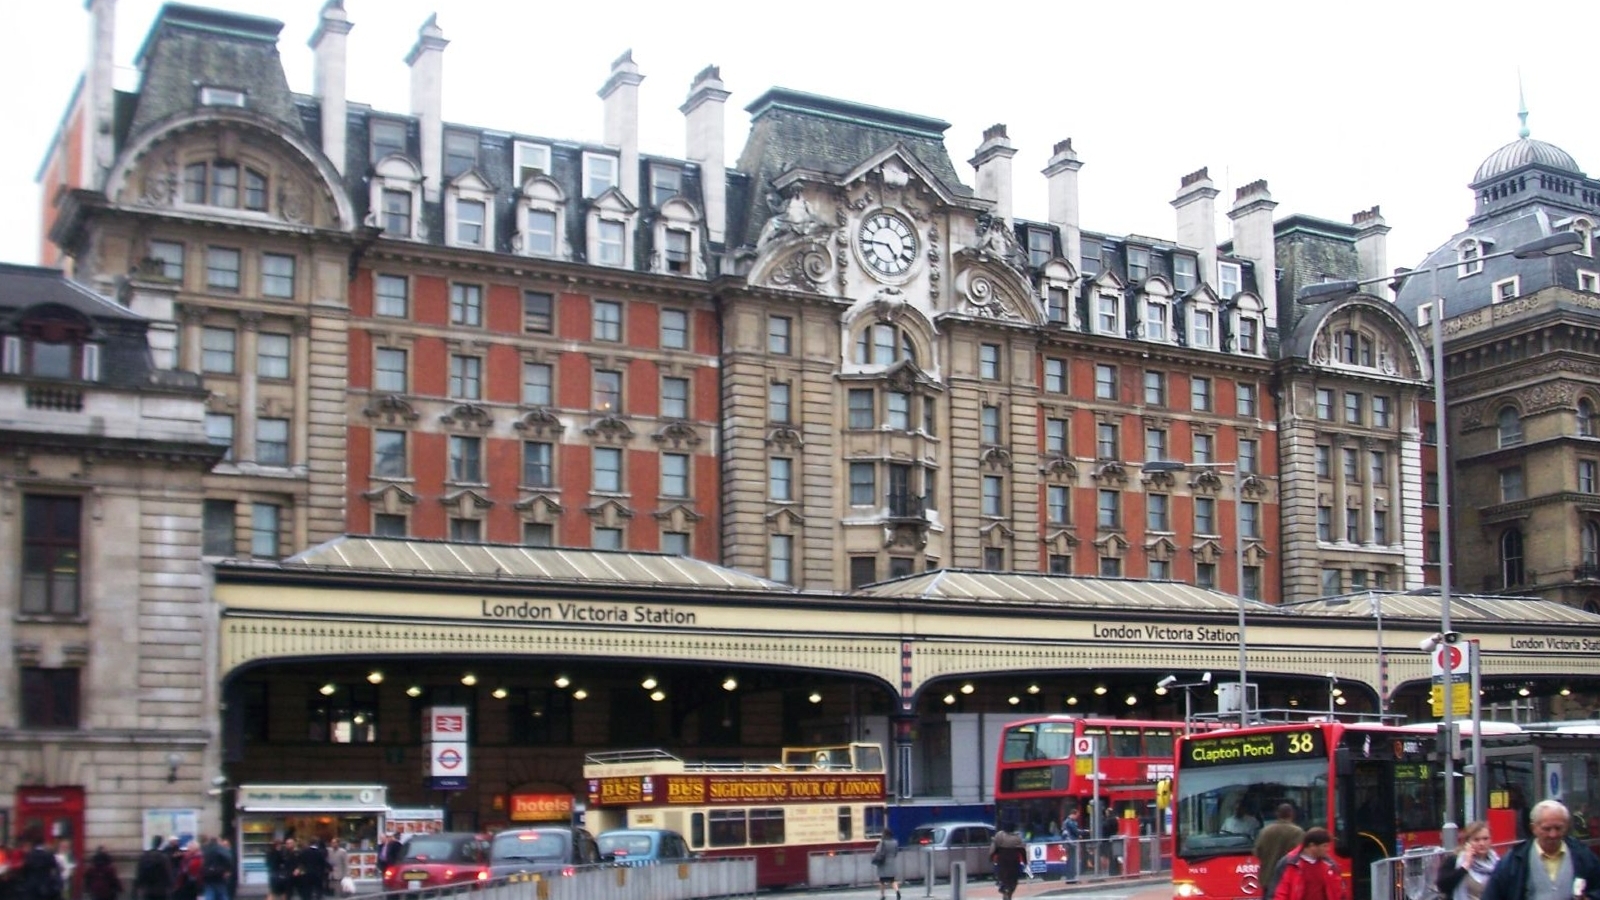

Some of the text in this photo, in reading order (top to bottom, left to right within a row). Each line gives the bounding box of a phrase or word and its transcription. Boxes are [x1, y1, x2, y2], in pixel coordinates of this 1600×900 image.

[481, 599, 696, 624] London Victoria Station
[1093, 623, 1240, 642] London Victoria Station
[1510, 637, 1543, 650] London
[1546, 637, 1580, 650] Victoria
[1286, 732, 1314, 754] 38
[1192, 742, 1274, 763] Clapton Pond
[601, 783, 641, 796] BUS
[668, 783, 704, 796] BUS
[709, 781, 882, 798] SIGHTSEEING TOUR OF LONDON
[516, 799, 570, 812] hotels
[1235, 864, 1261, 874] ARRI
